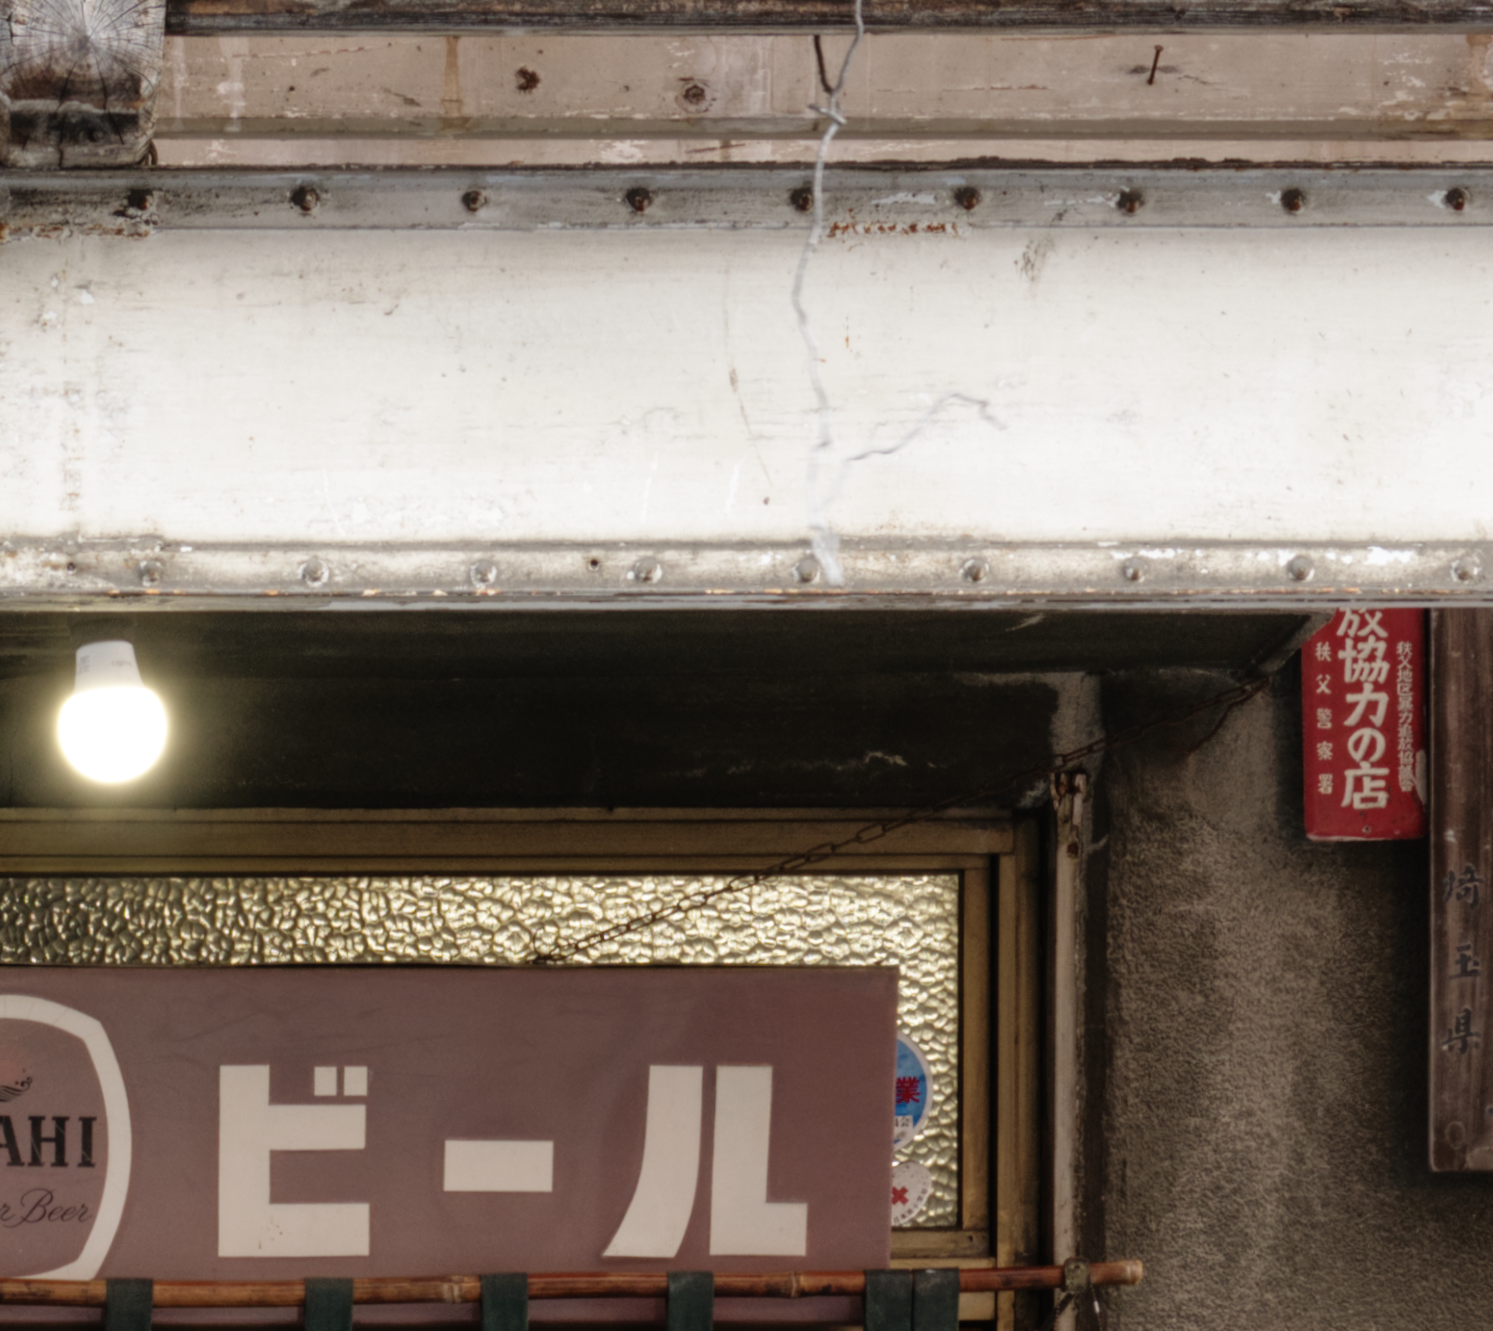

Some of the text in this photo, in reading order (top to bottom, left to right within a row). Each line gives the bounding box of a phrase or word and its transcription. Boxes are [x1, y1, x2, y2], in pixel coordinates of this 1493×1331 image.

[1315, 640, 1334, 795] 秩父警察署
[2, 1187, 93, 1229] Beer
[217, 1062, 808, 1258] ビール
